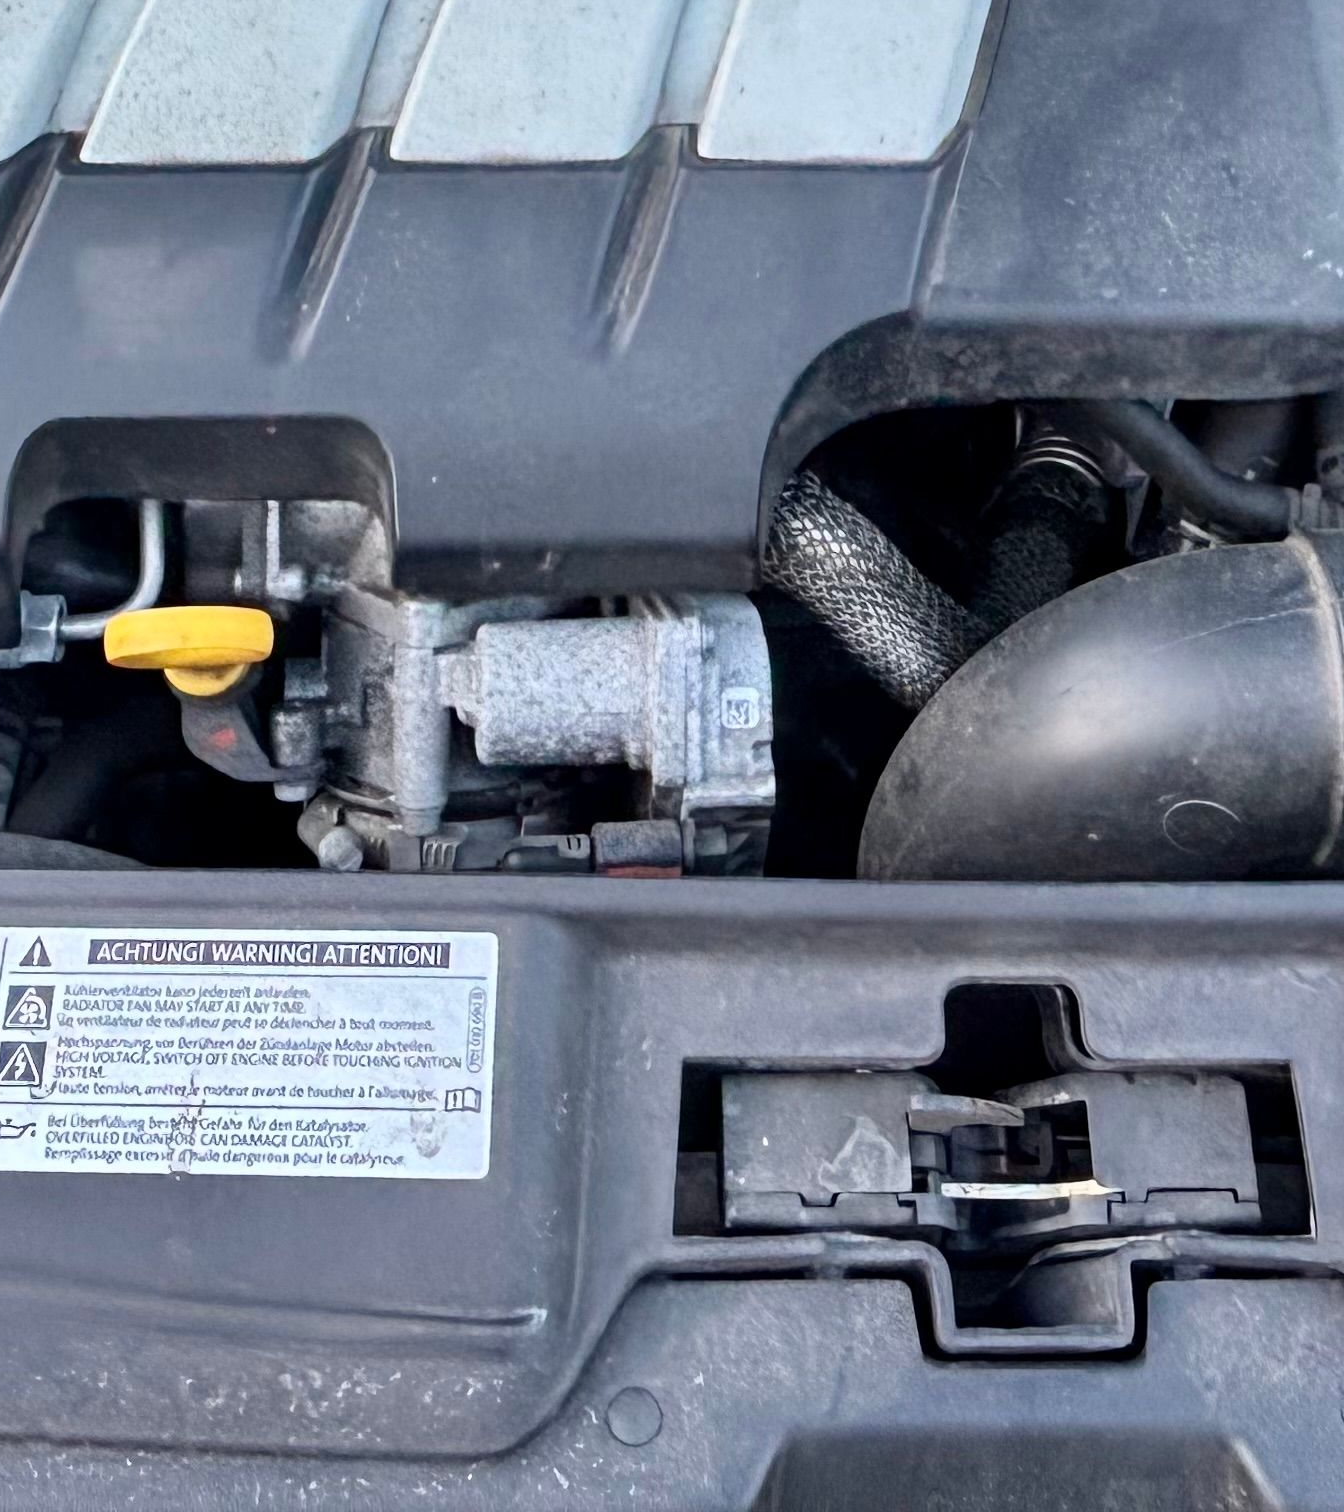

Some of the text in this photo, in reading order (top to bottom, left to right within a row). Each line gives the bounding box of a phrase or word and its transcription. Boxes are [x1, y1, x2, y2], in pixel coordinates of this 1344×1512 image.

[96, 941, 443, 966] ACHTUNG! WARNING! ATTENTION!
